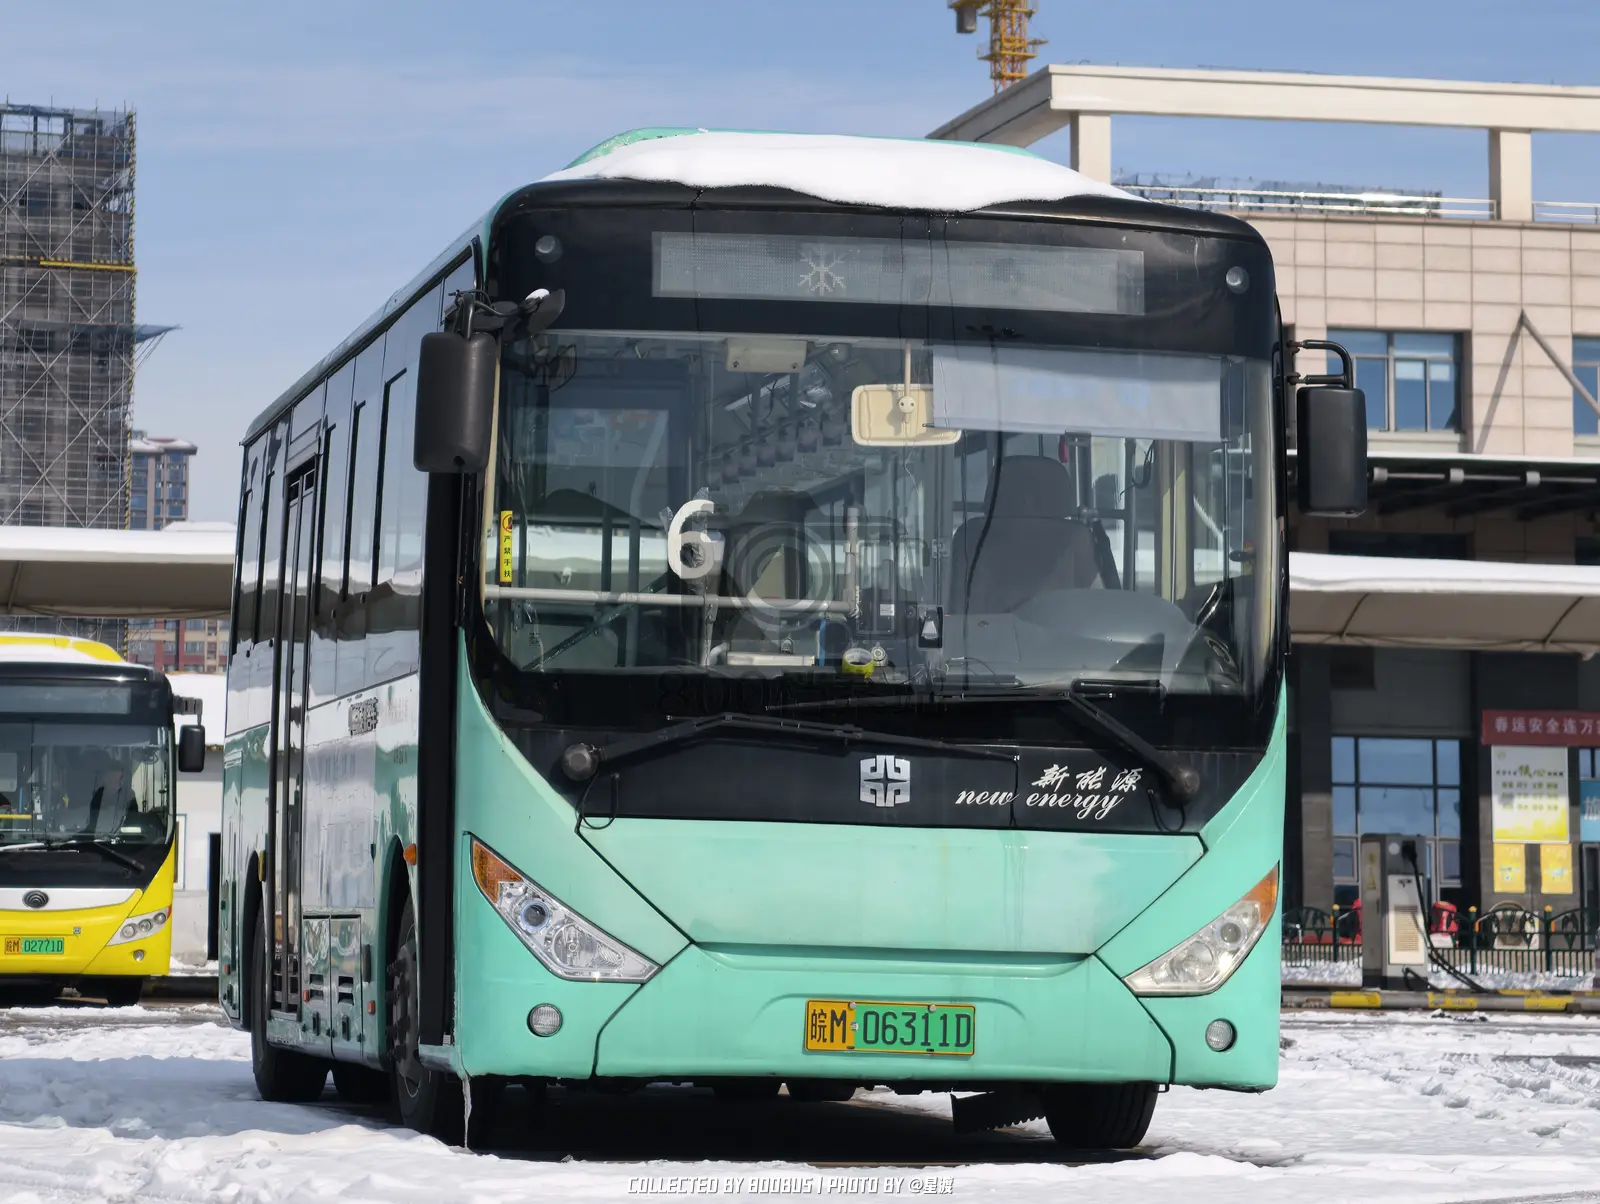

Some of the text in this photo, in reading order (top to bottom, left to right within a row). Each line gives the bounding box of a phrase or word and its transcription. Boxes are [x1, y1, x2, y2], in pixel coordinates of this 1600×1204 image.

[503, 535, 511, 577] 严禁手扶
[668, 499, 715, 580] 6
[1032, 764, 1143, 793] 新能源
[955, 788, 1125, 820] new energy
